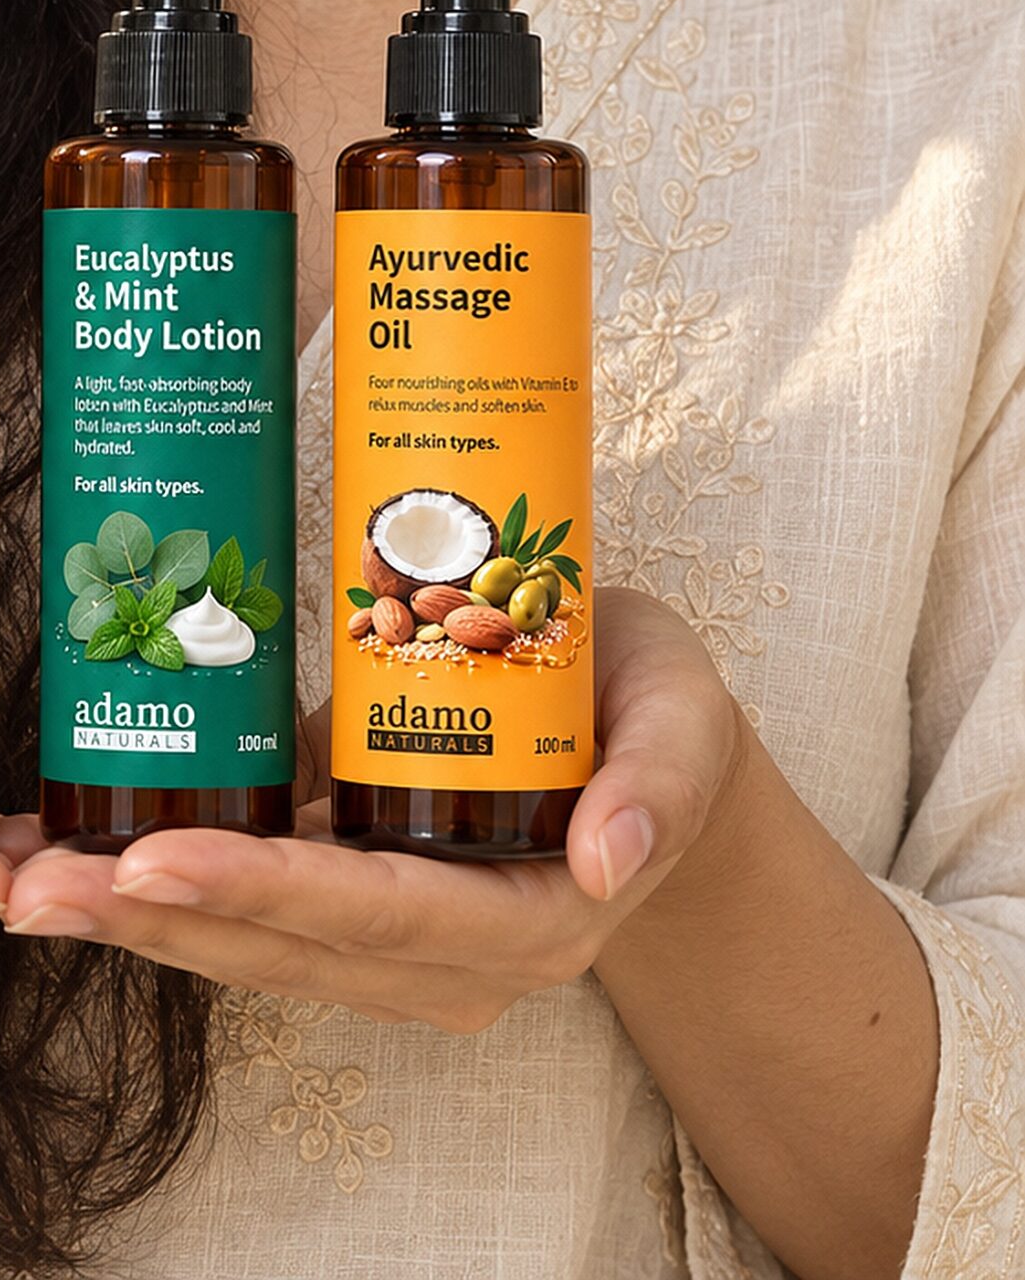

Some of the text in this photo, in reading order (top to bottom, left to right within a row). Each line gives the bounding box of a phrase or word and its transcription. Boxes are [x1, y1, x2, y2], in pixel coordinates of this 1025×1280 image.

[75, 243, 234, 278] Eucalyptus
[369, 242, 529, 278] Ayurvedic
[75, 280, 179, 311] & Mint
[370, 282, 511, 319] Massage
[75, 319, 262, 357] Body Lotion
[369, 319, 412, 350] Oil
[75, 377, 84, 390] A
[220, 378, 252, 396] body
[397, 376, 466, 394] nourishing
[467, 377, 490, 390] oils
[492, 377, 518, 390] with
[520, 378, 561, 391] Vitamin
[113, 398, 141, 412] with
[144, 398, 219, 417] Eucalyptus
[221, 399, 246, 413] and
[453, 399, 478, 413] and
[481, 398, 520, 413] soften
[175, 419, 206, 436] soft,
[208, 419, 235, 434] cool
[237, 419, 261, 434] and
[75, 439, 135, 458] hydrated.
[368, 432, 500, 453] For all skin types.
[75, 477, 204, 497] For all skin types.
[75, 692, 195, 728] adamo
[368, 695, 492, 731] adamo
[78, 731, 190, 749] NATURALS
[371, 733, 488, 752] NATURALS
